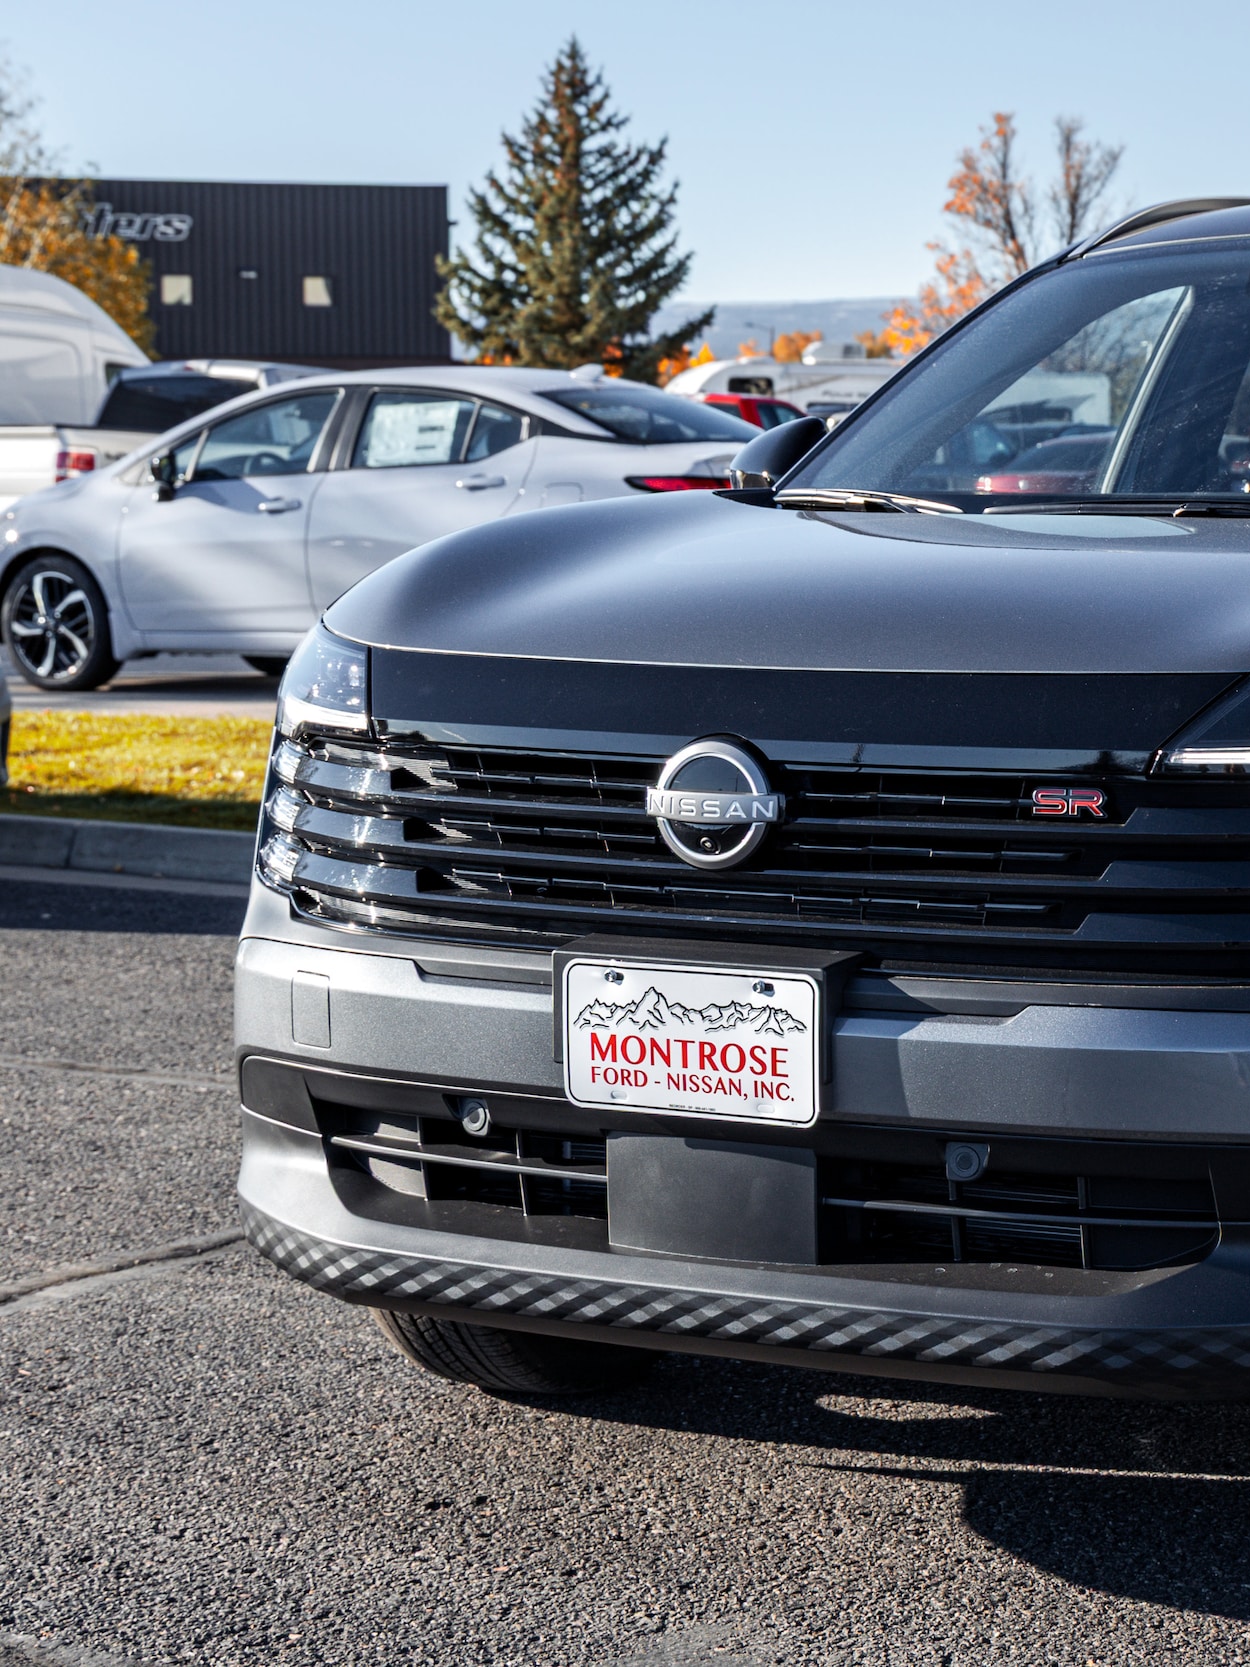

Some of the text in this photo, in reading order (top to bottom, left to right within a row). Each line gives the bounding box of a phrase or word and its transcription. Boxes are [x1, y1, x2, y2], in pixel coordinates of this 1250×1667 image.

[649, 793, 775, 819] NISSAN
[1031, 788, 1104, 817] SR
[590, 1031, 790, 1078] MONTROSE
[591, 1066, 649, 1088] FORD
[666, 1072, 749, 1101] NISSAN,
[752, 1080, 796, 1102] INC.
